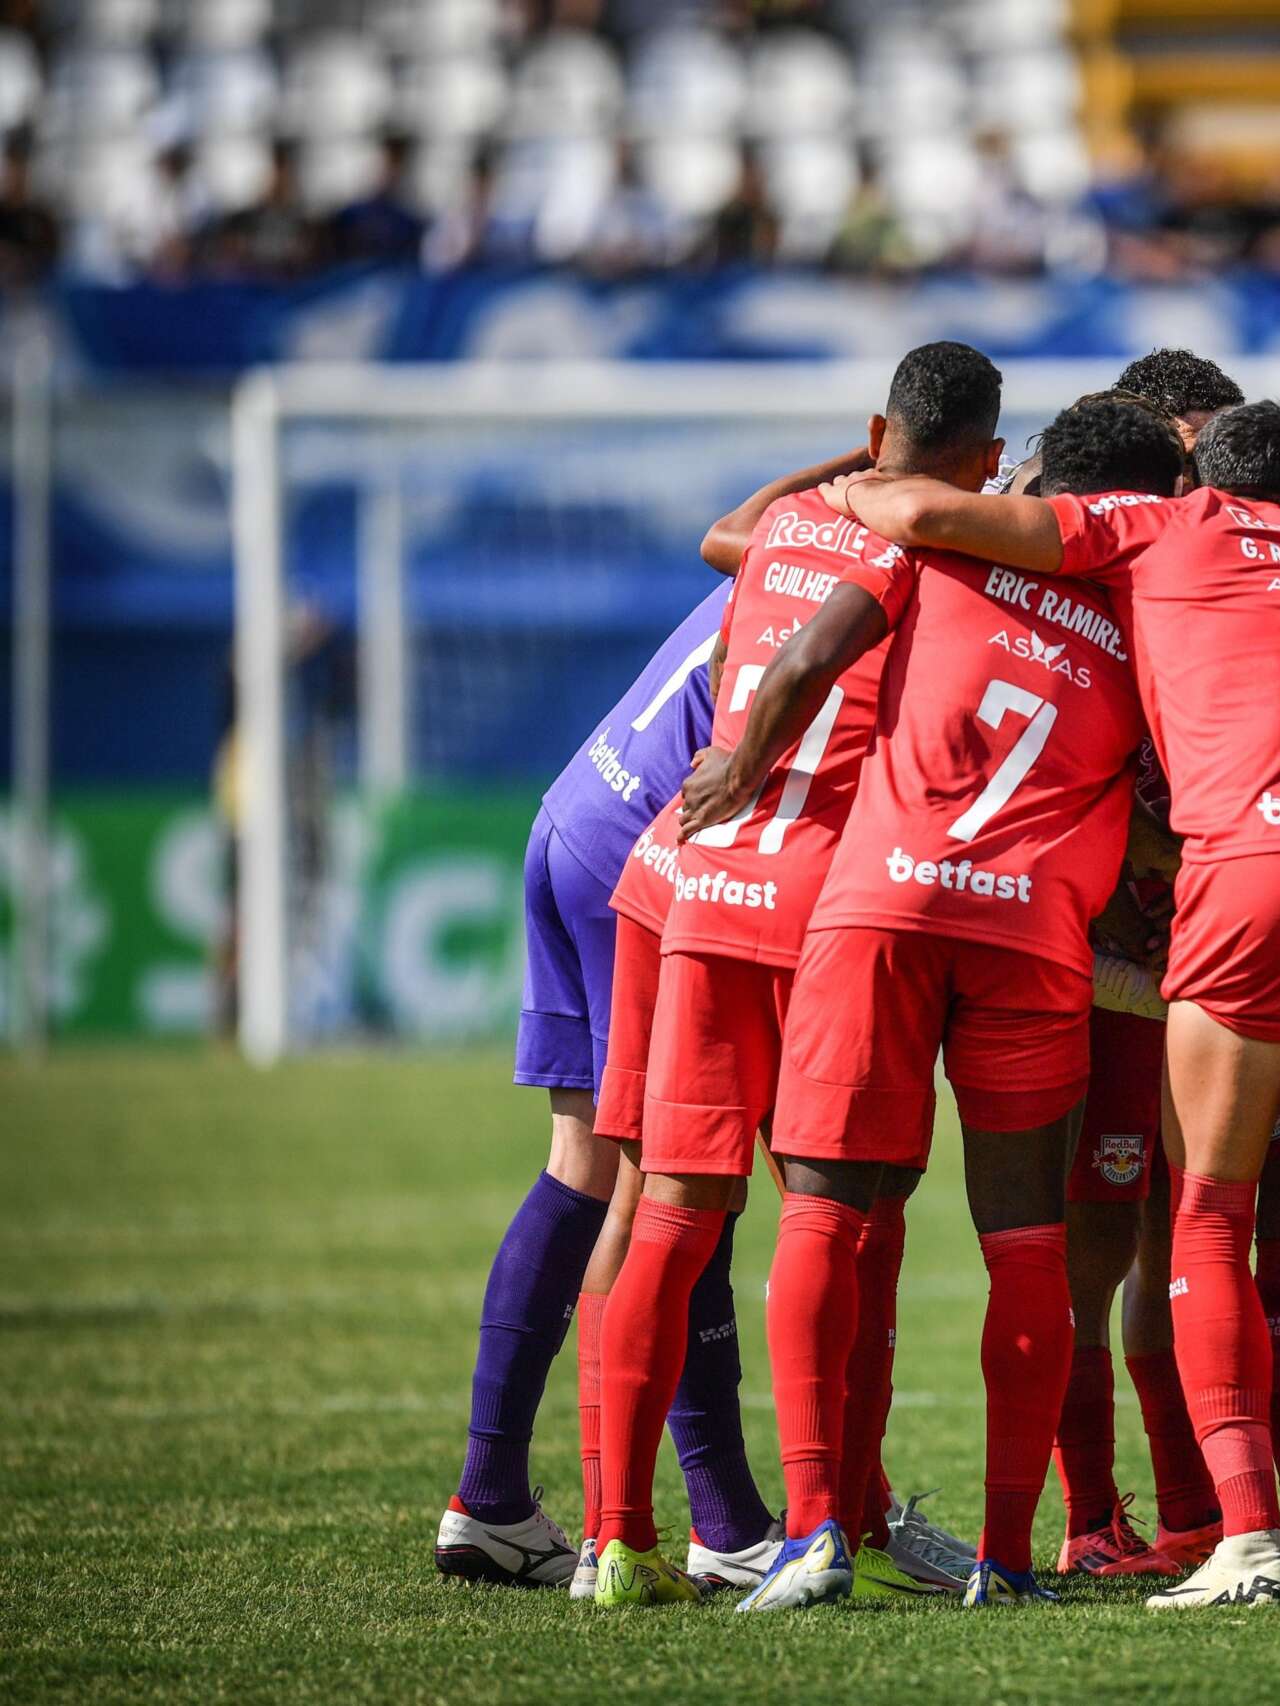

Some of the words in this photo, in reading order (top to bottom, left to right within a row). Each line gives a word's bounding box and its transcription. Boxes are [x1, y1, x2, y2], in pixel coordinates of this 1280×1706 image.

[765, 511, 846, 552] Red
[1240, 537, 1265, 560] G.
[984, 566, 1039, 611] ERIC
[587, 726, 641, 802] betfast
[946, 679, 1058, 843] 7
[886, 847, 1033, 903] betfast
